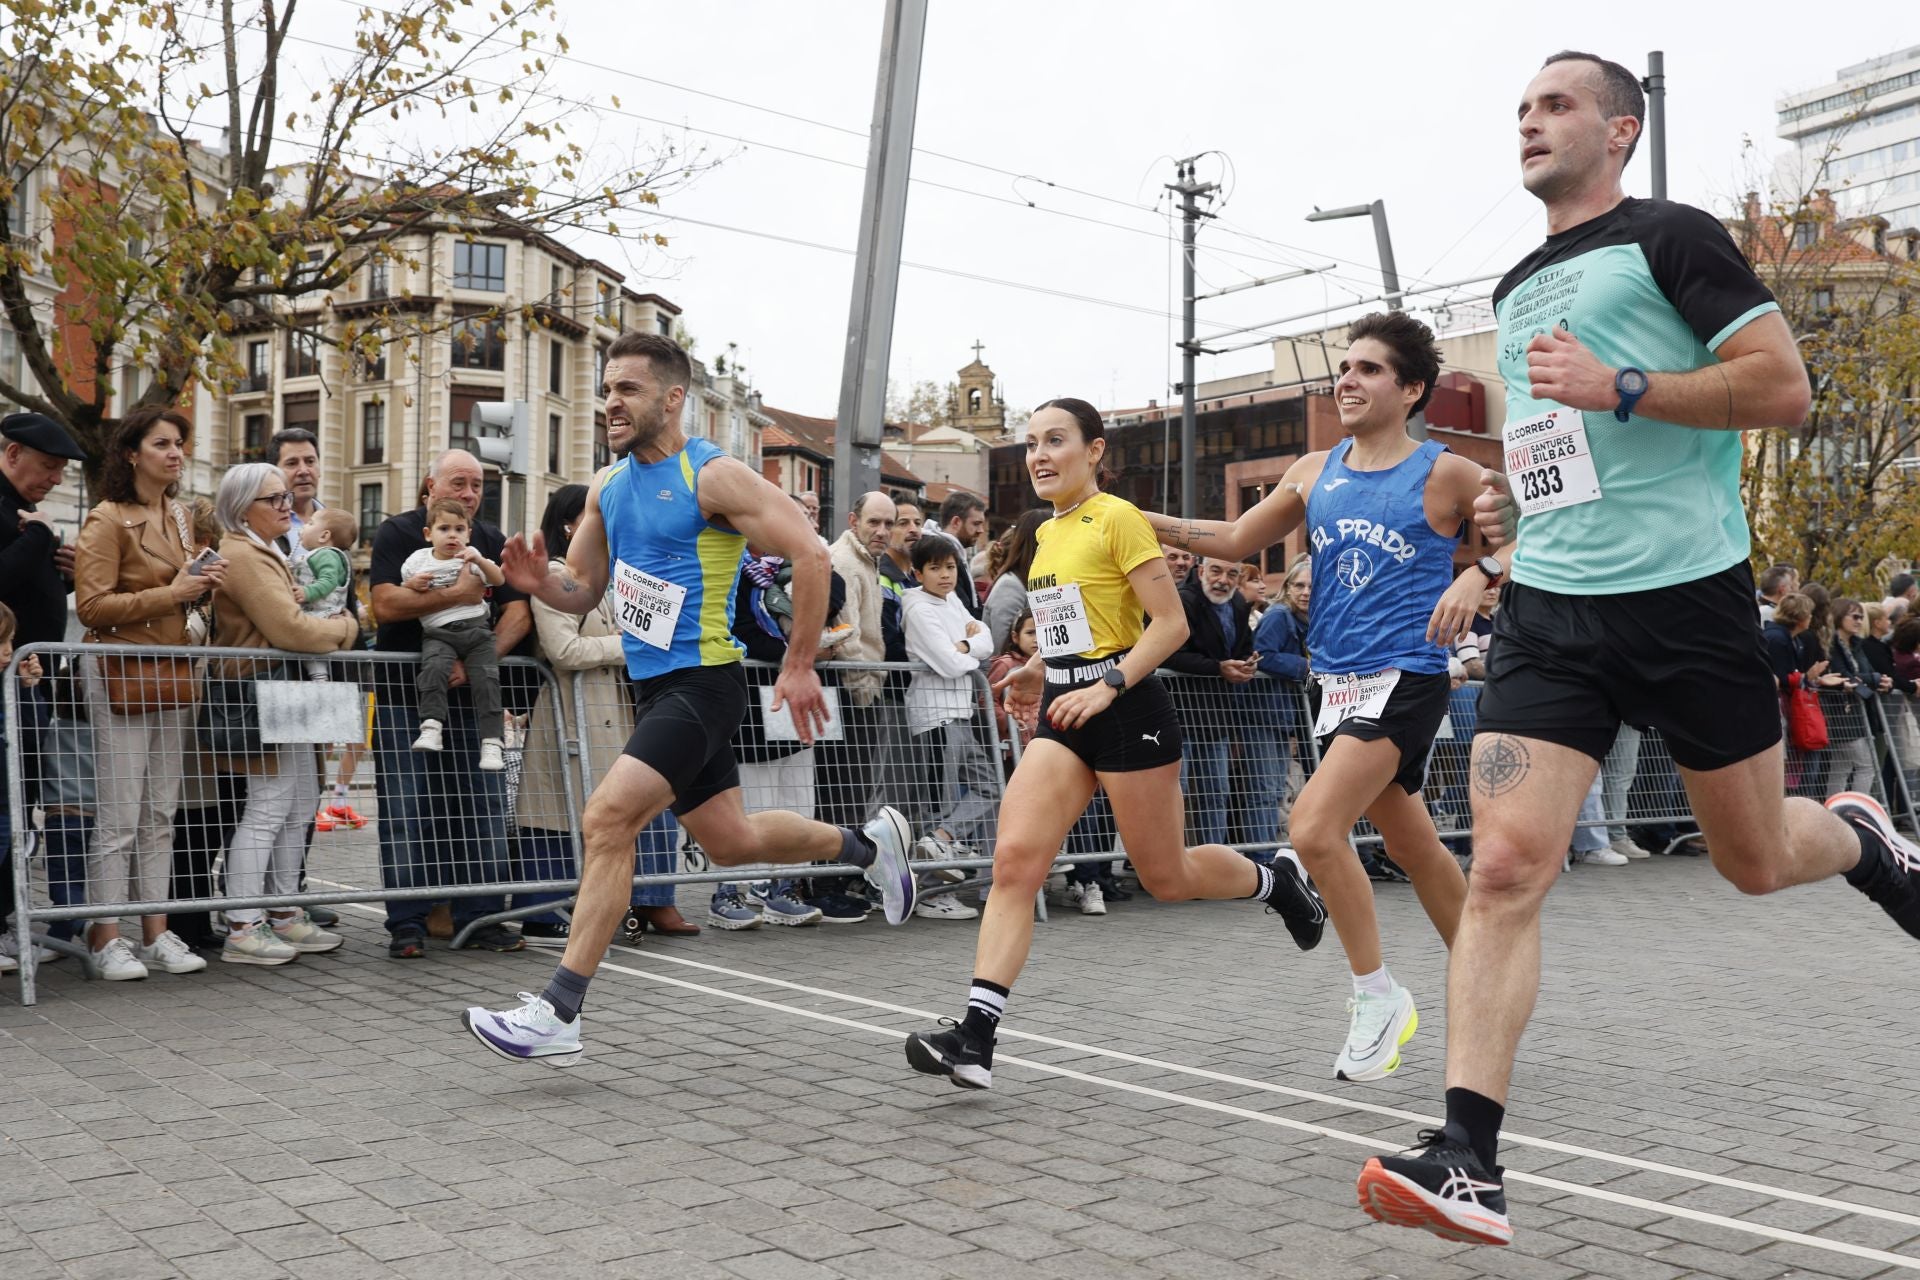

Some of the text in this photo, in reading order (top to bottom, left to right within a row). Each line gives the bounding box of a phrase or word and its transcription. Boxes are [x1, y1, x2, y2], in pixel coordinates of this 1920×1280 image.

[1533, 283, 1579, 312] INTERNACIONAL
[1507, 431, 1515, 442] EL
[1514, 419, 1555, 439] CORREO
[1530, 434, 1574, 454] SANTURCE
[1507, 444, 1576, 472] XXXVI BILBAO
[1521, 464, 1563, 501] 2333
[1311, 518, 1416, 564] EL PRADO
[624, 568, 632, 578] EL
[632, 573, 665, 592] CORREO
[1028, 573, 1057, 592] UNNING
[617, 579, 639, 603] XXXVI
[638, 597, 670, 616] BILBAO
[640, 591, 672, 609] SANTURCE
[1035, 595, 1043, 604] EL
[1042, 592, 1062, 603] CORREO
[622, 601, 653, 632] 2766
[1049, 604, 1075, 615] SANTURCE
[1050, 611, 1077, 623] BILBAO
[1044, 624, 1070, 648] 1138
[1336, 676, 1347, 685] EL
[1347, 671, 1382, 684] CRREO
[1327, 688, 1358, 707] XXXVI
